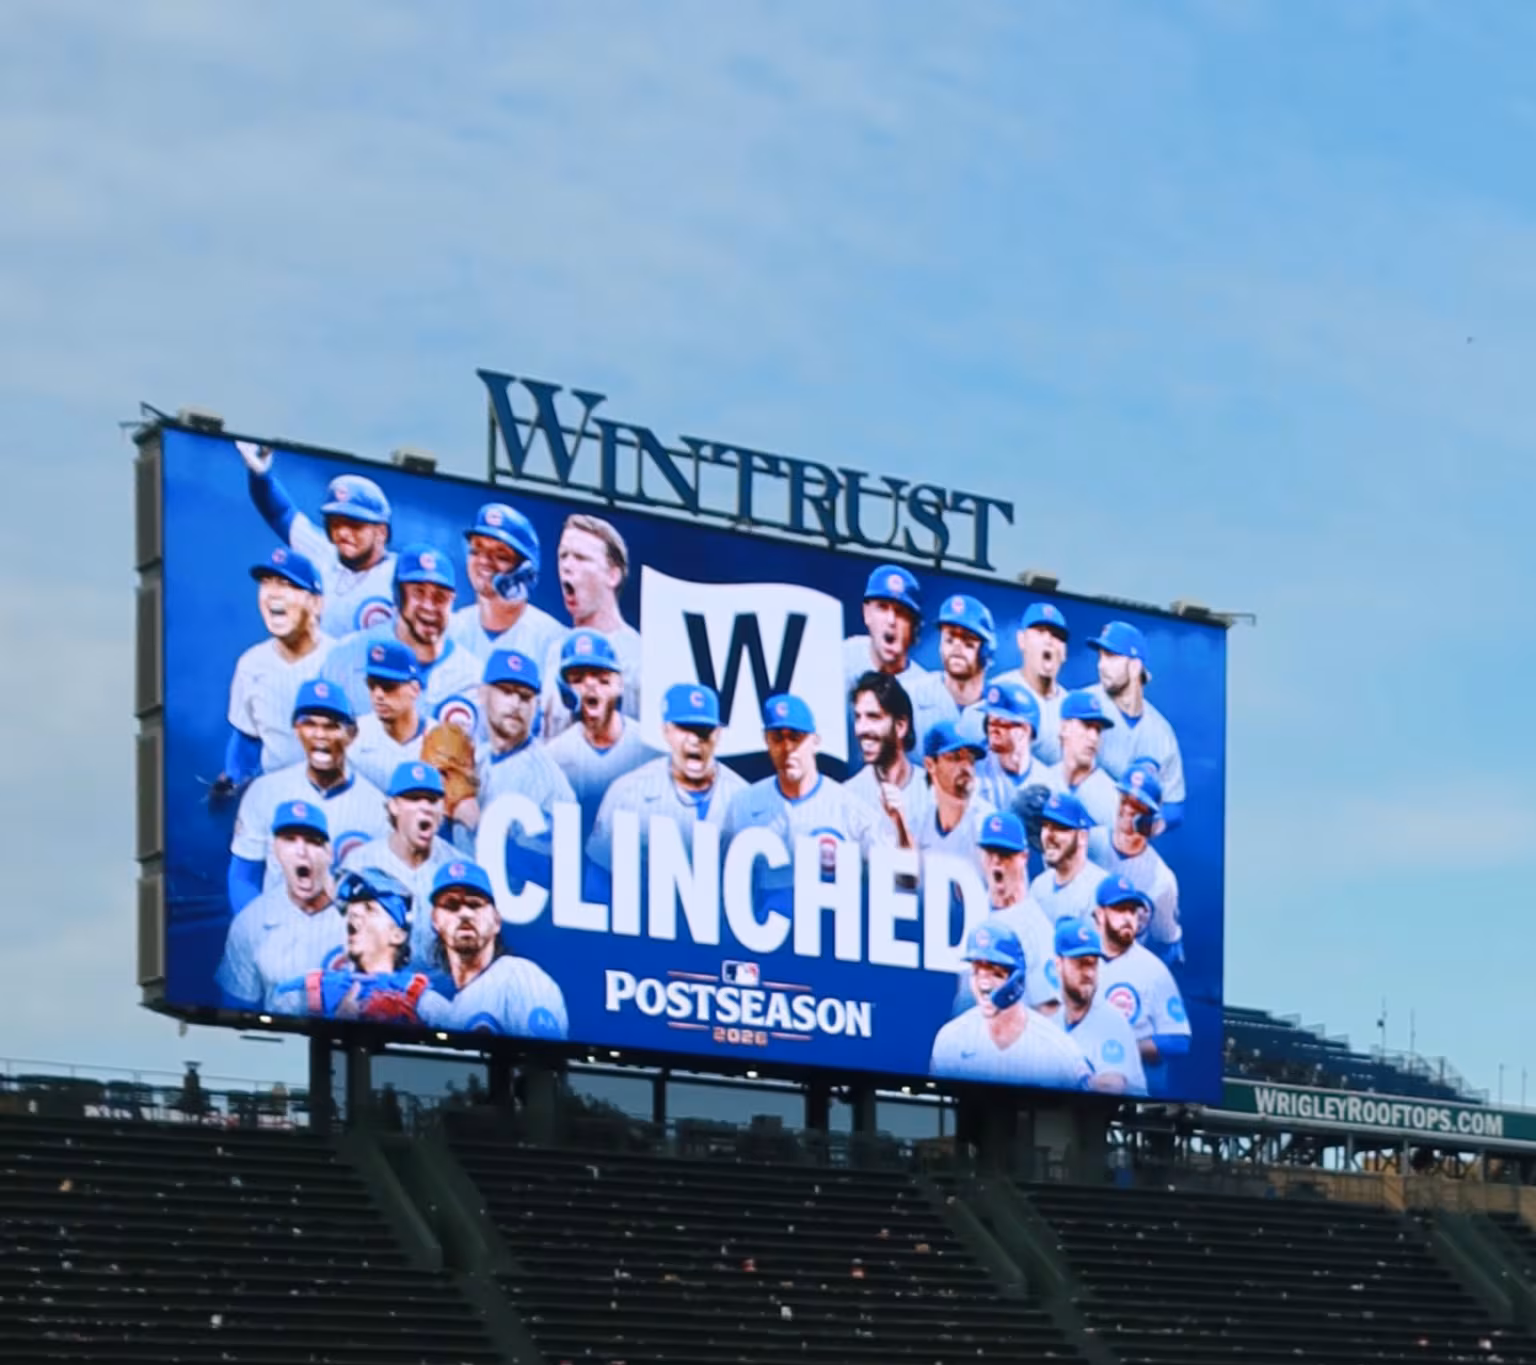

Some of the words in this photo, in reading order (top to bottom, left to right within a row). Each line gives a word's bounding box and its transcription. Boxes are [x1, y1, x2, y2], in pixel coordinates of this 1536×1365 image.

[476, 368, 1014, 571] WINTRUST
[682, 610, 807, 728] W
[476, 793, 991, 973] CLINCHED
[604, 969, 873, 1038] POSTSEASON
[1254, 1087, 1503, 1137] WRIGLEYROOFTOPS.COM
